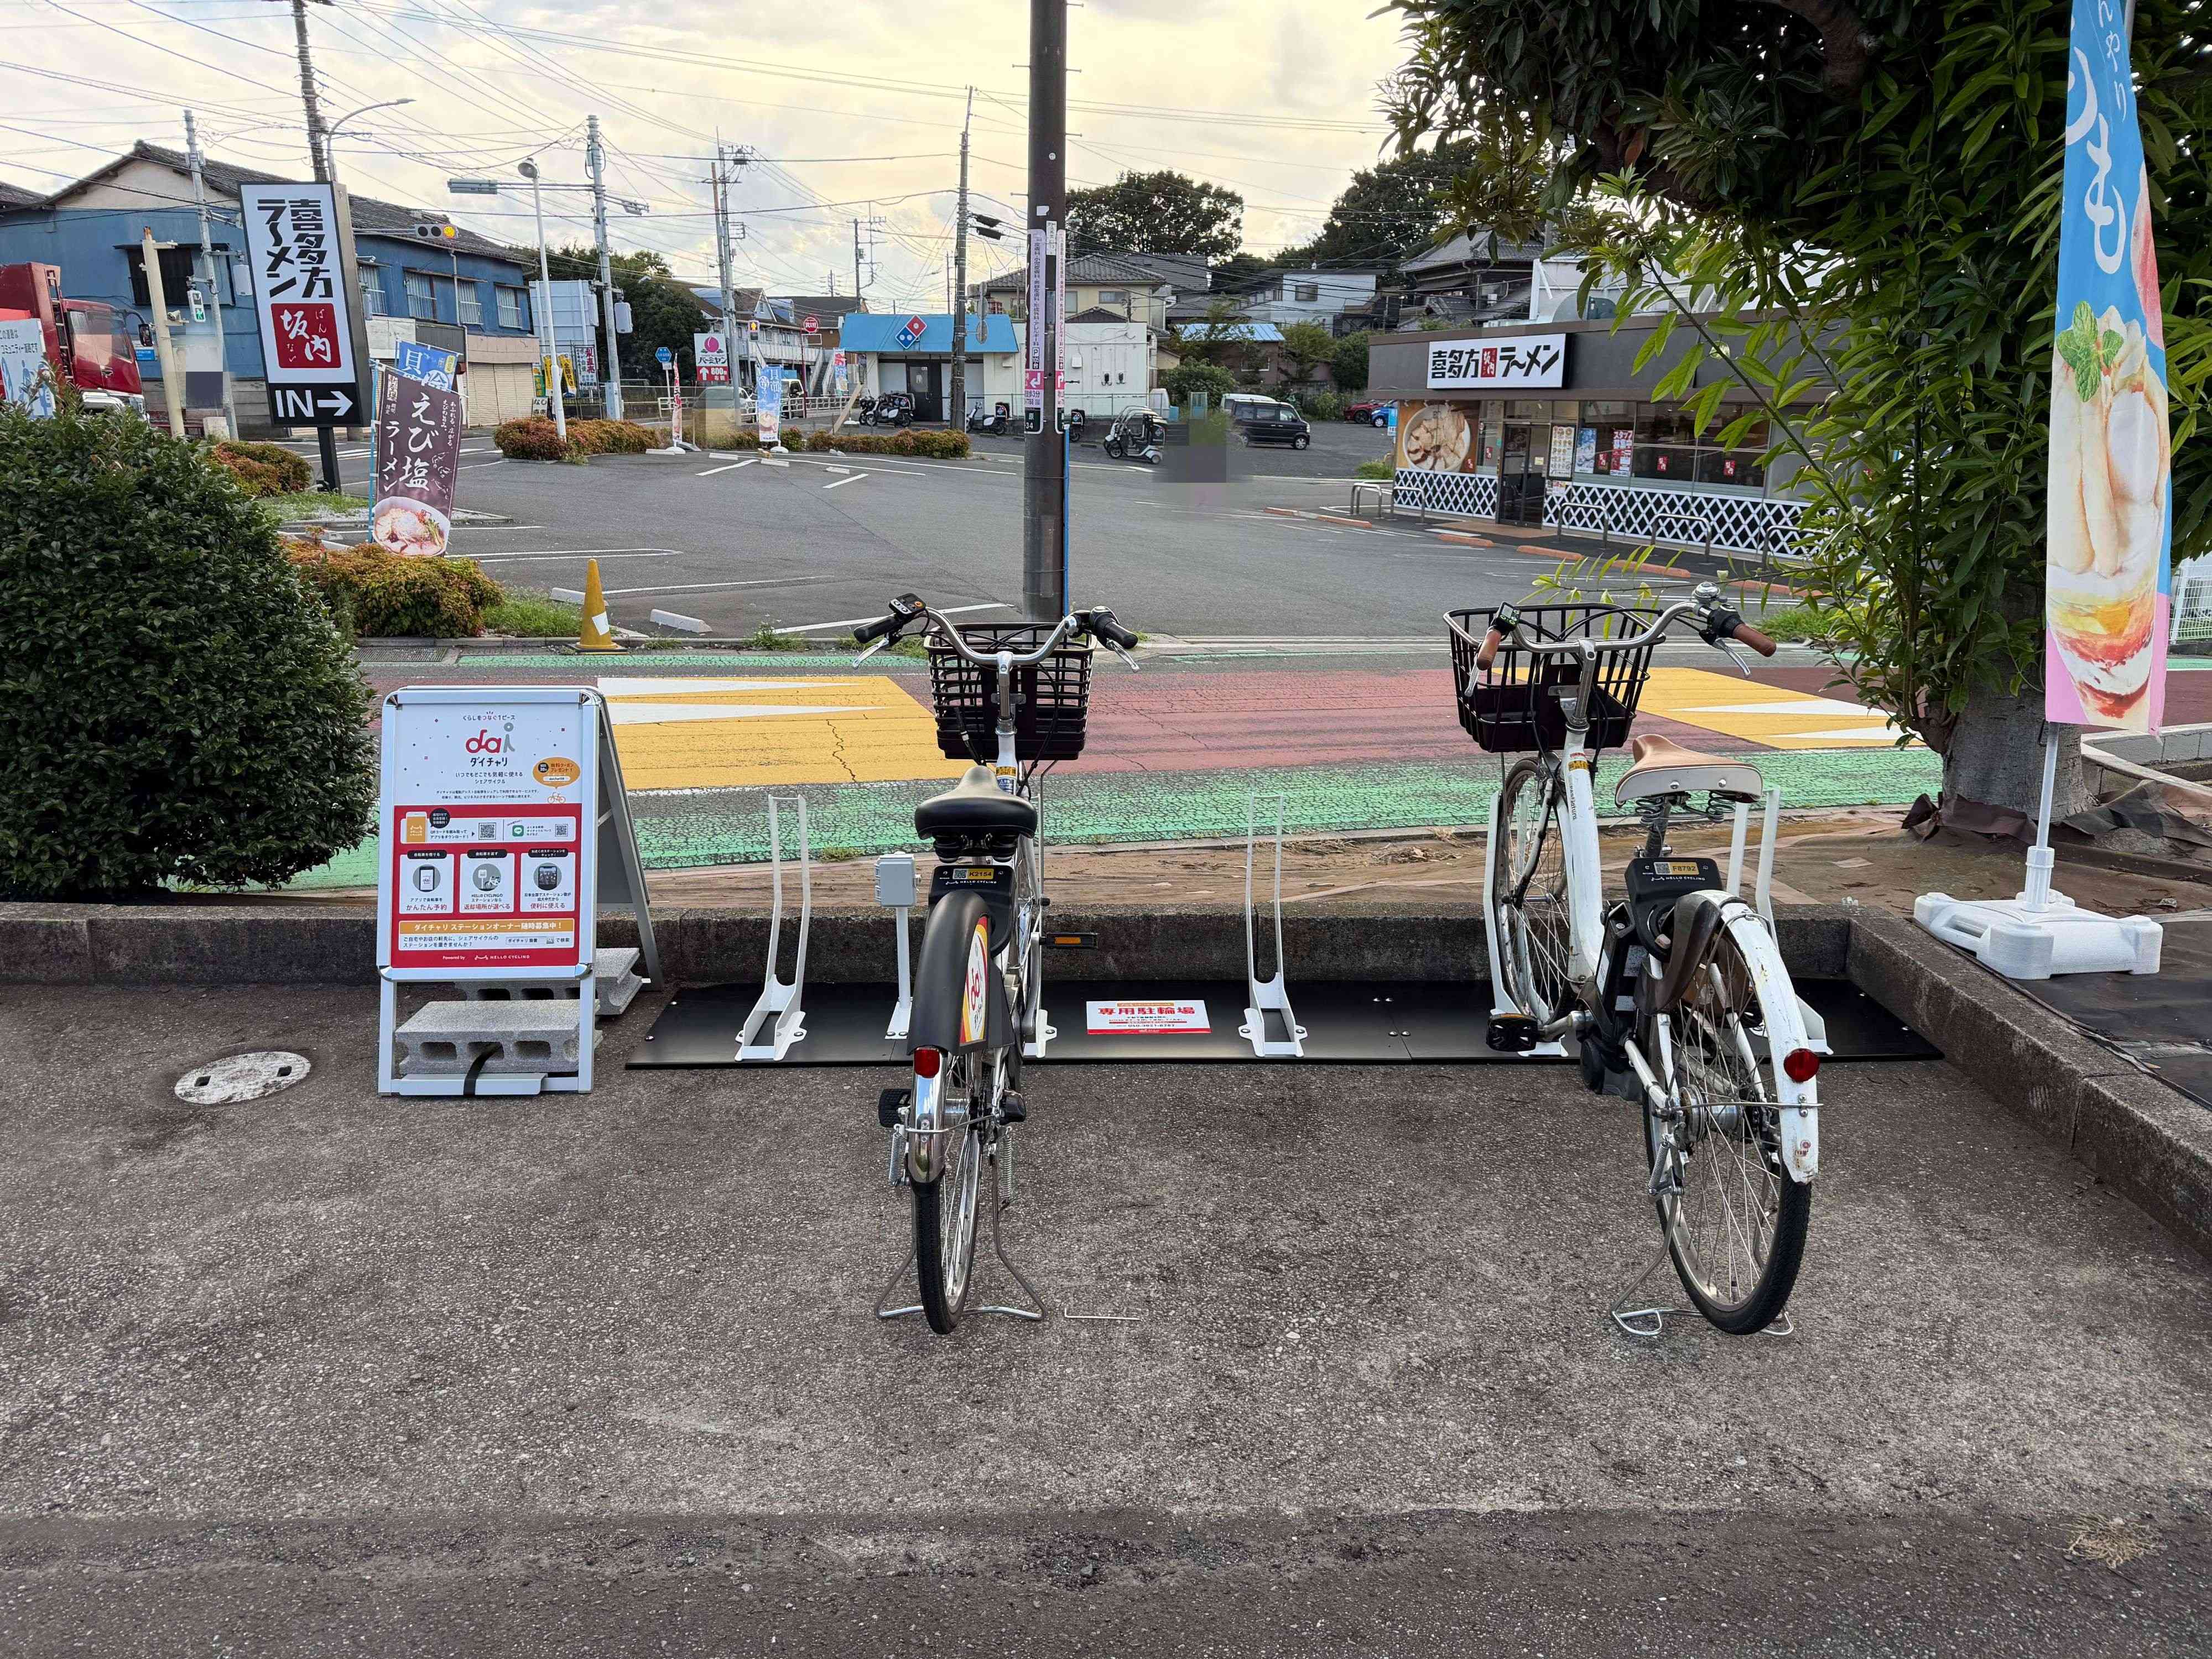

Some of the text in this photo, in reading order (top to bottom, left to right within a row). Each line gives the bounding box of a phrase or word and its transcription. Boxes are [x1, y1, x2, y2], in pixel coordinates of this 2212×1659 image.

[288, 199, 334, 298] 喜多方
[280, 309, 331, 363] 坂内
[315, 309, 327, 333] ばん
[1432, 348, 1480, 379] 喜多方
[275, 389, 315, 418] IN
[382, 421, 400, 492] ラーメン
[399, 392, 439, 491] えび塩
[465, 722, 515, 754] dai
[470, 757, 508, 767] ダイチャリ
[451, 922, 562, 931] ステーションオーナー随時募集中！
[1097, 1007, 1195, 1016] 専用駐輪場
